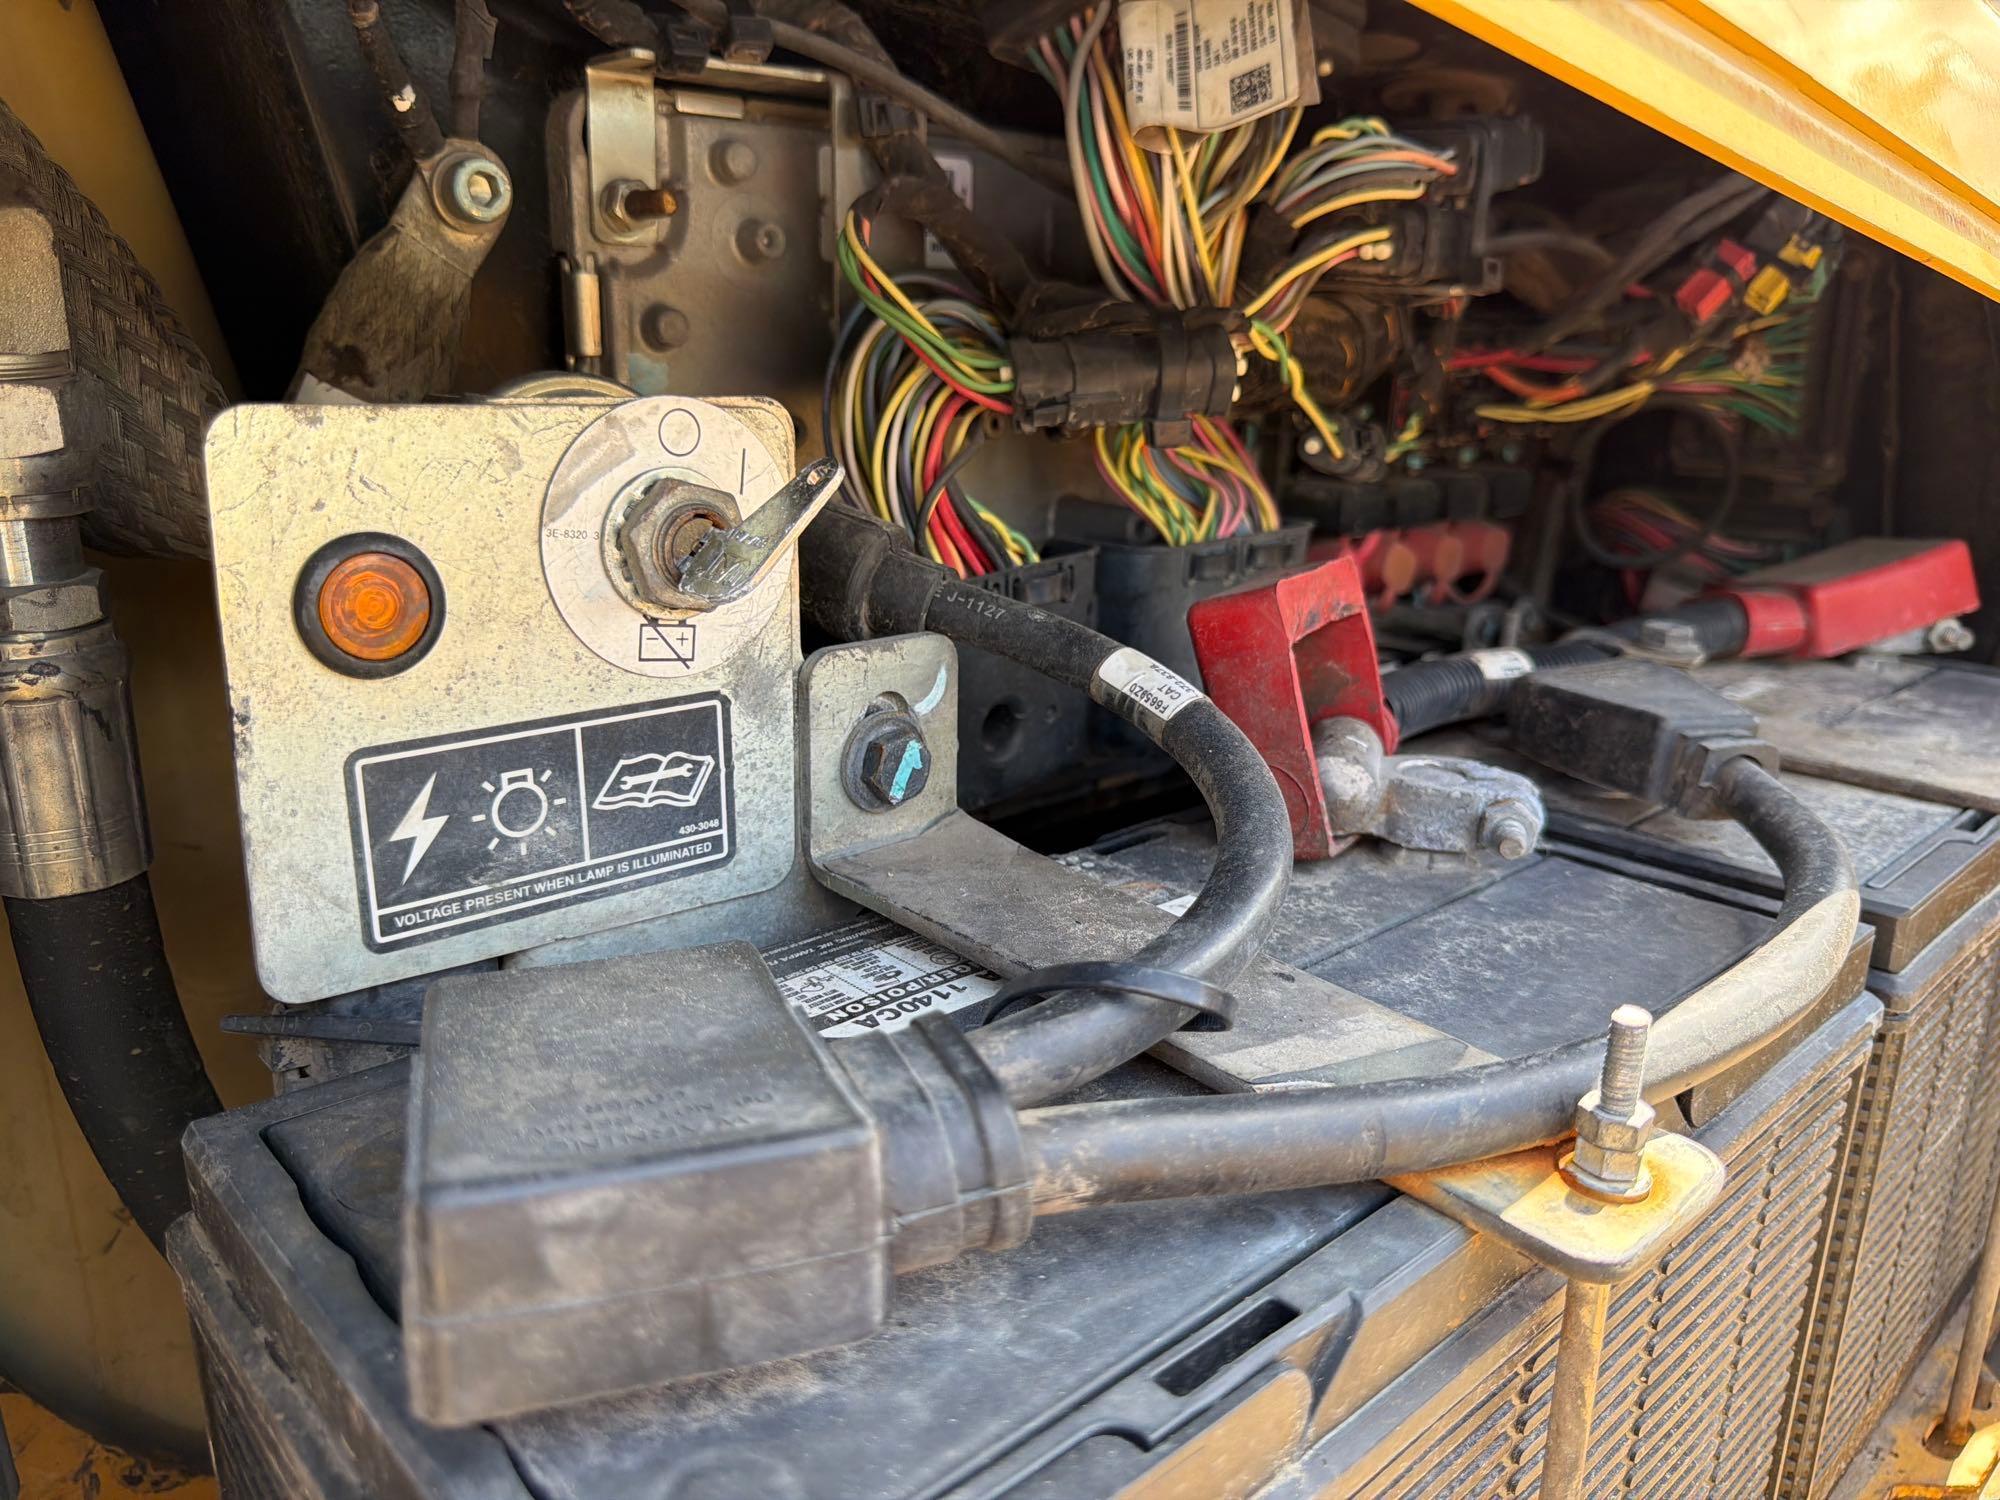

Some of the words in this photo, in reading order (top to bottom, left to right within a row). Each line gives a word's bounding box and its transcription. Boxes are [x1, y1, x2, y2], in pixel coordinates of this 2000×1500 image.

[546, 528, 588, 539] 3E-8320
[947, 591, 1007, 620] J-1127
[1157, 684, 1181, 700] CAT
[678, 818, 720, 836] 430-3048
[394, 903, 462, 928] VOLTAGE
[465, 886, 531, 911] PRESENT
[534, 875, 575, 896] WHEN
[578, 866, 614, 884] LAMP
[617, 862, 629, 873] IS
[632, 841, 712, 870] ILLUMINATED
[852, 985, 968, 1029] 1140CA
